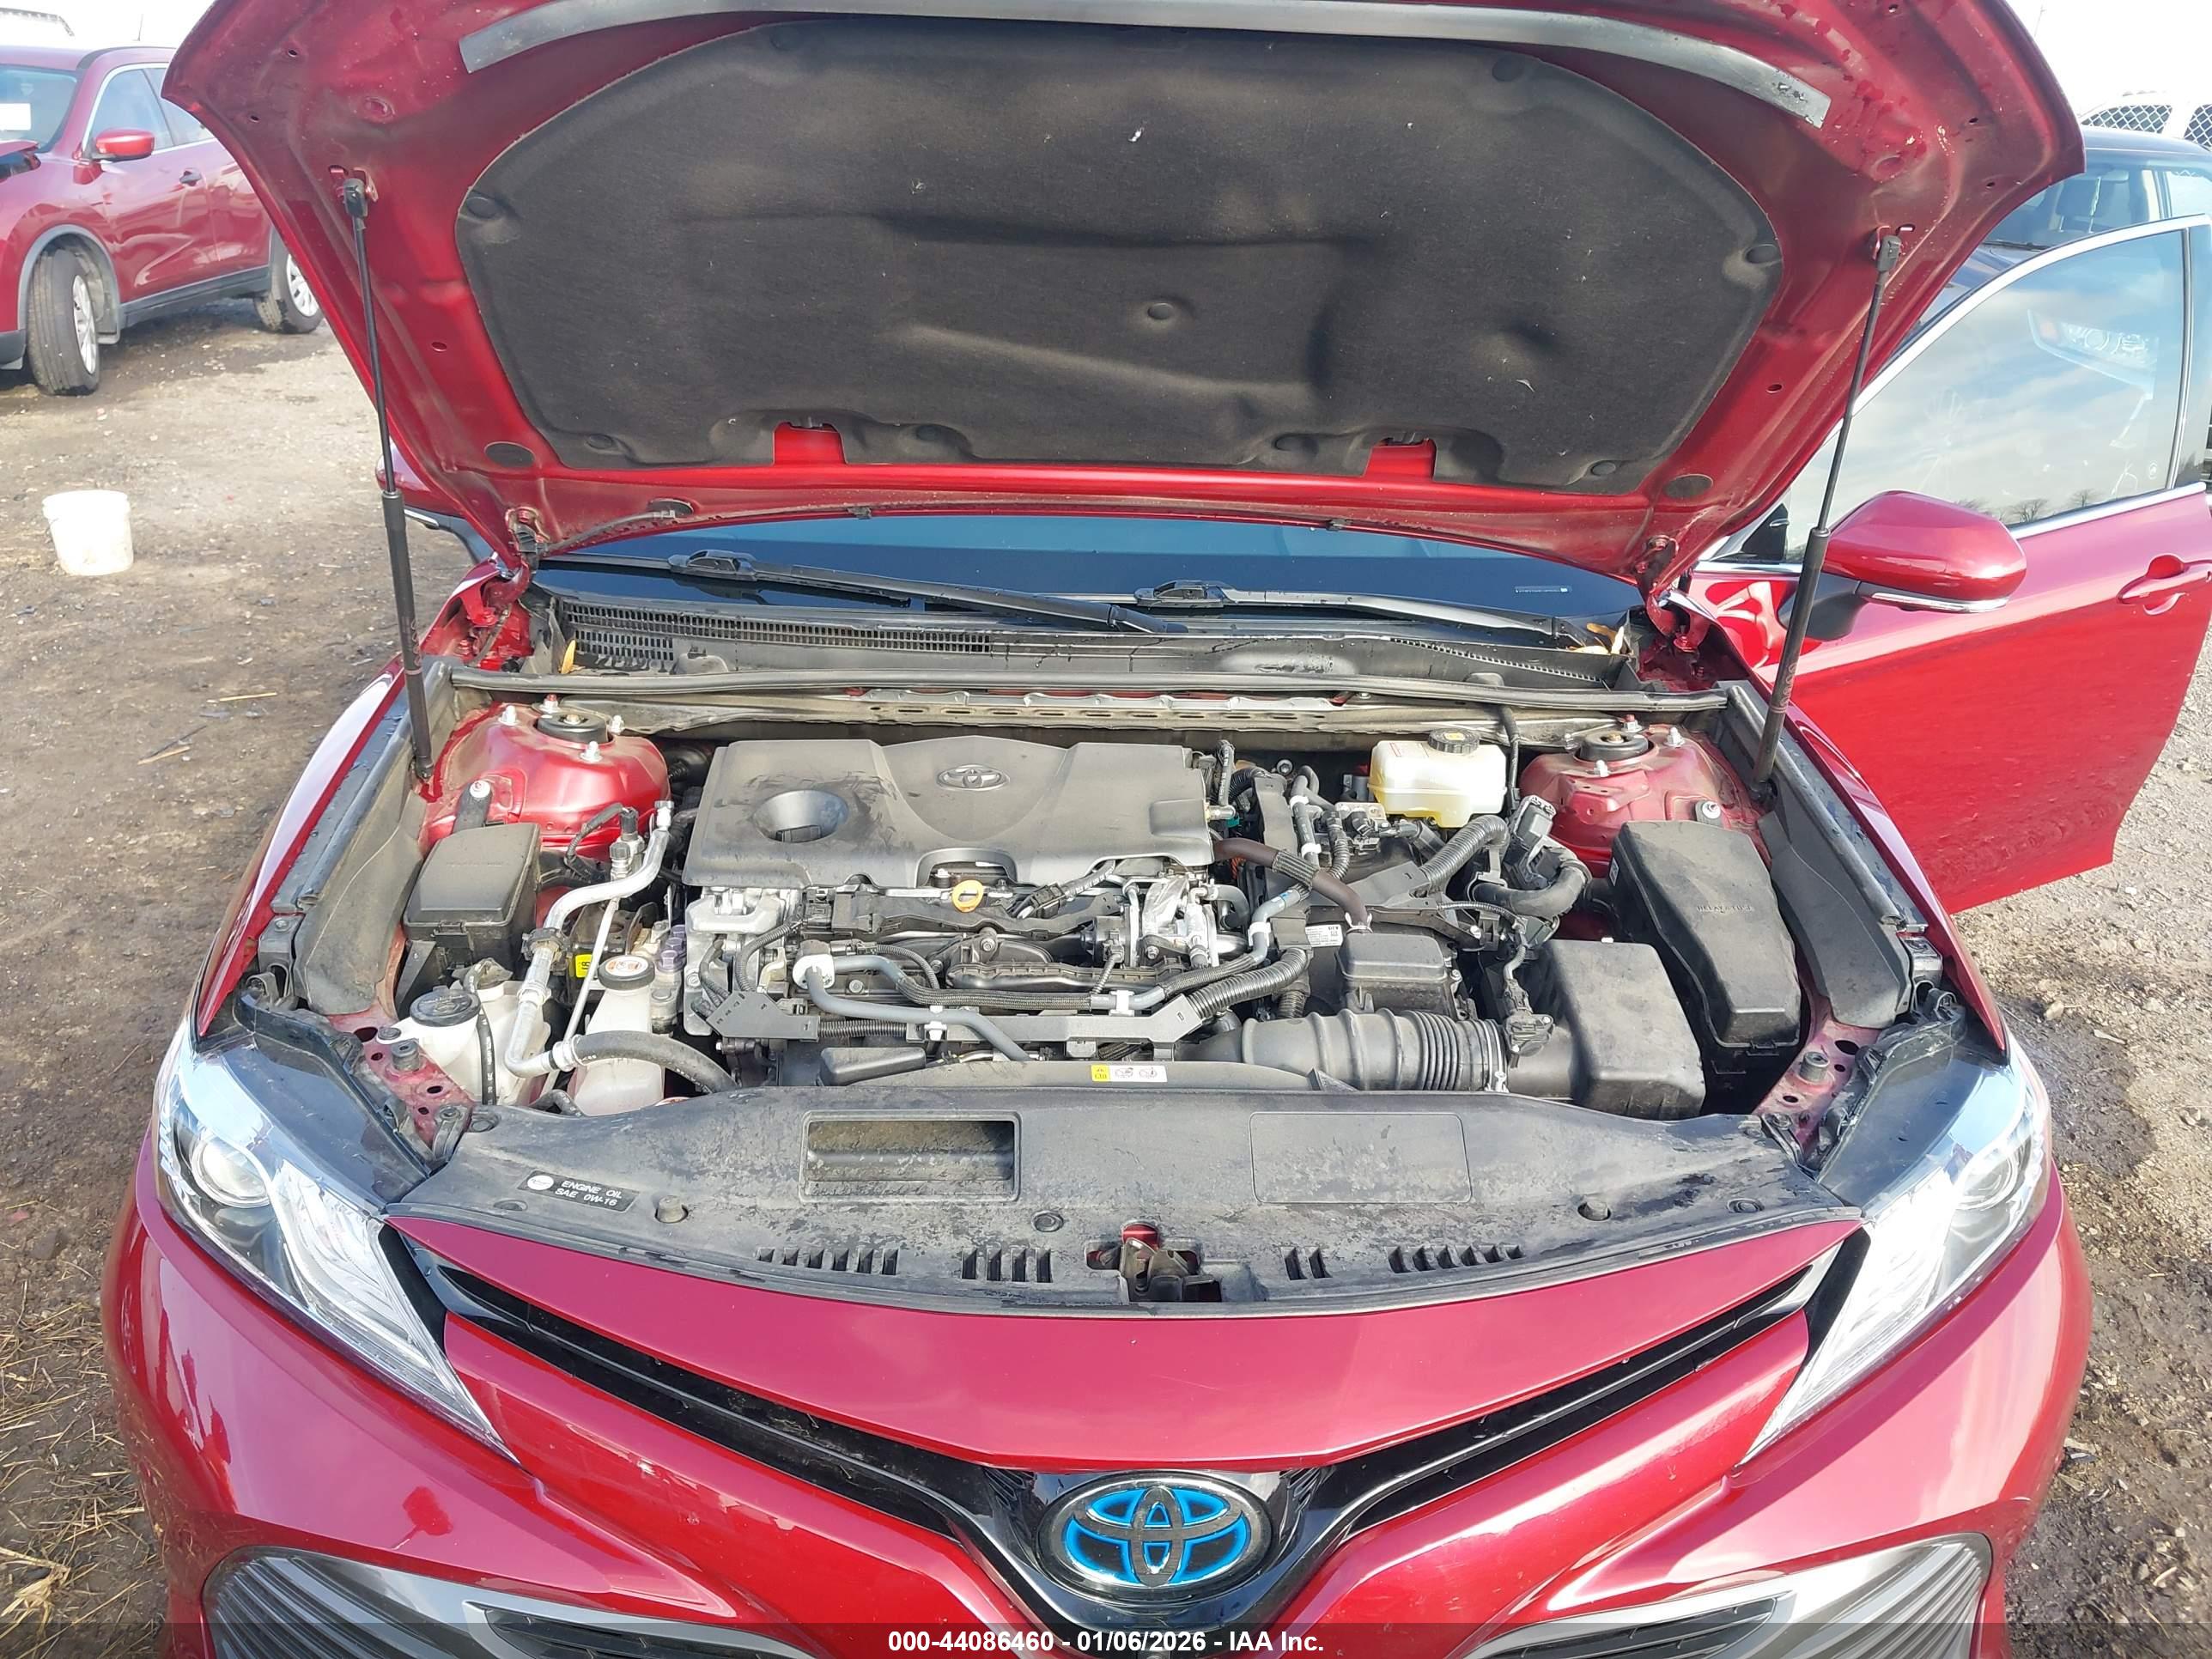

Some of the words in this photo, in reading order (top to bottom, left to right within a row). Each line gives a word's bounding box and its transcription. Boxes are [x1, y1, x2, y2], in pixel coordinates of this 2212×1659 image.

[555, 1188, 579, 1198] SAE
[583, 1194, 617, 1206] 0W-16
[562, 1181, 601, 1194] ENGINE
[605, 1189, 623, 1199] OIL
